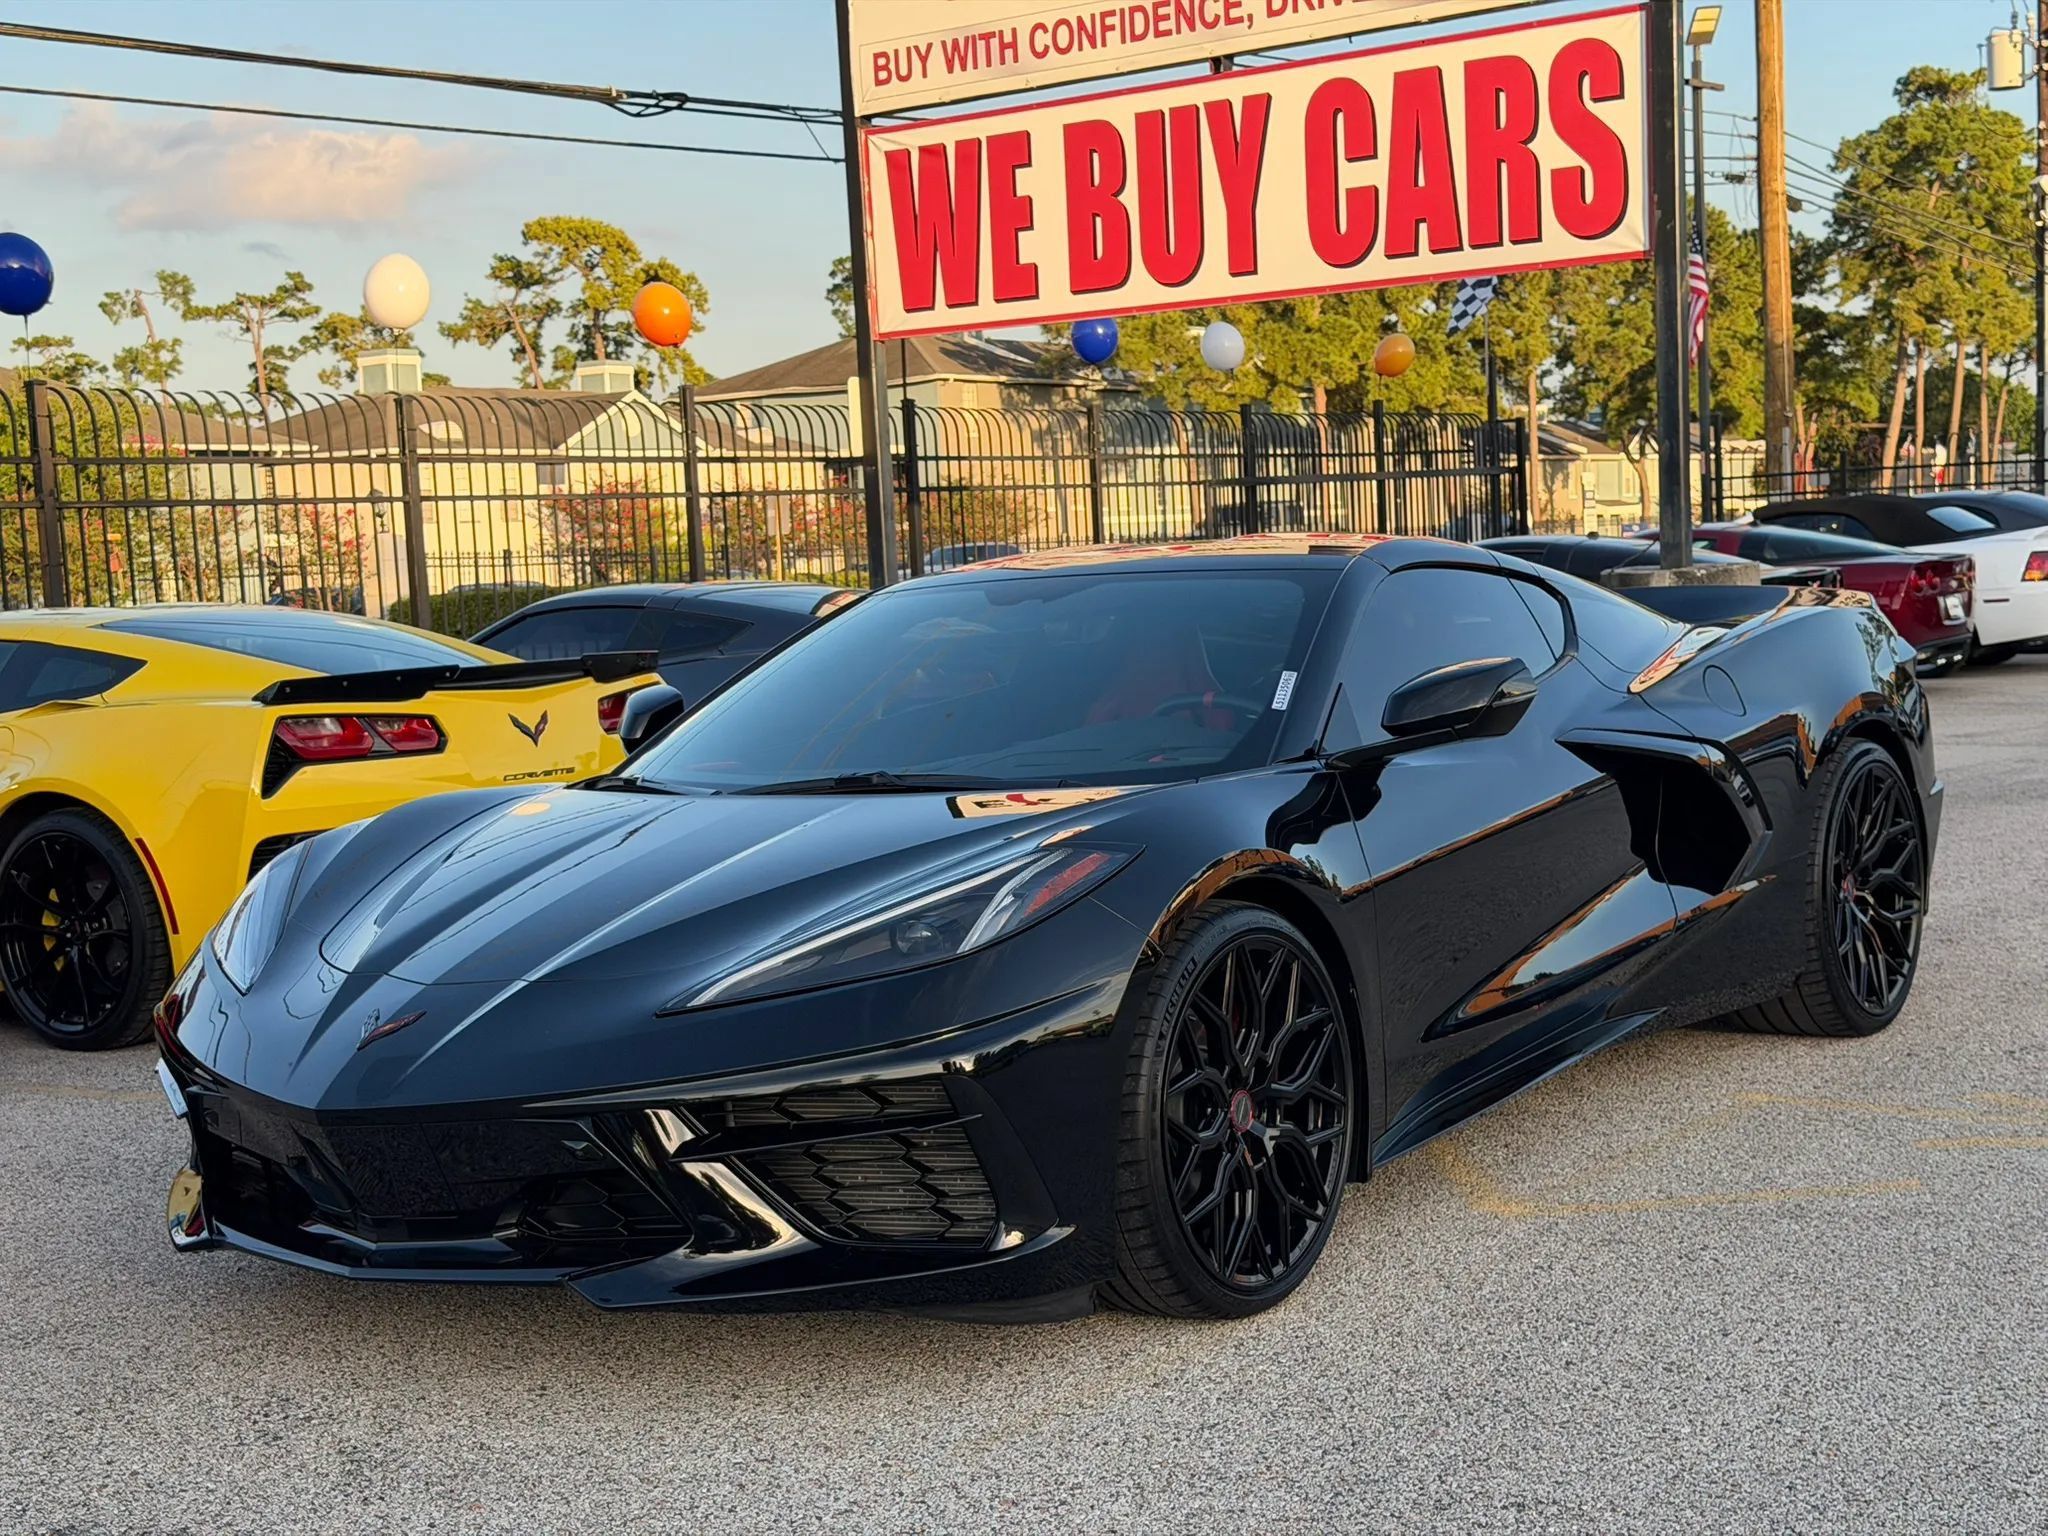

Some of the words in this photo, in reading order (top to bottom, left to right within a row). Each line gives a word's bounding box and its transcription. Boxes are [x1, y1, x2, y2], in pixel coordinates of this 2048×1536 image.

[872, 42, 933, 87] BUY
[940, 27, 1019, 74] WITH
[1029, 0, 1254, 60] CONFIDENCE,
[885, 130, 1041, 314] WE
[1063, 93, 1271, 296] BUY
[1304, 38, 1630, 268] CARS
[504, 767, 575, 781] CORVETTE
